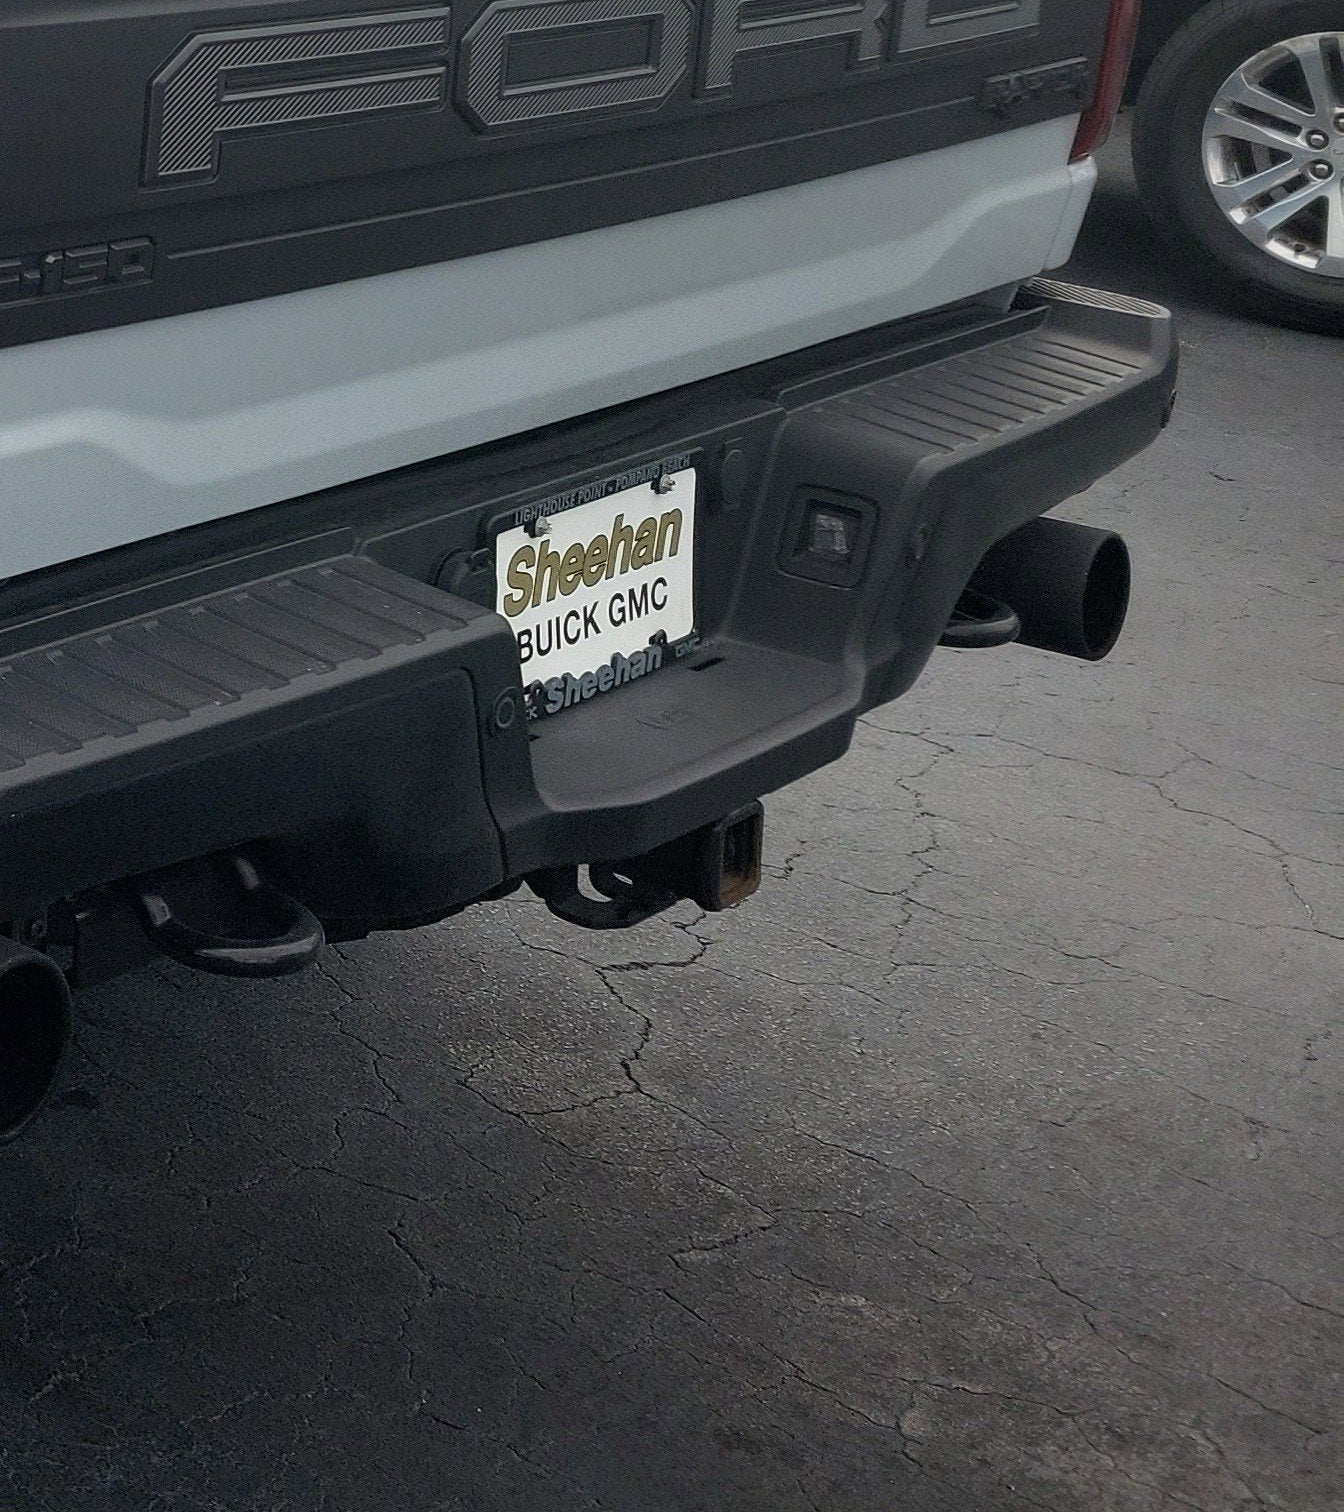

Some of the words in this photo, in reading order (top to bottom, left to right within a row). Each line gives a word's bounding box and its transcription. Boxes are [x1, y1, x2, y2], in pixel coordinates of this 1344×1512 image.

[514, 495, 575, 525] LIGHTHOUSE
[577, 482, 607, 506] POINT
[503, 508, 683, 618] Sheehan
[518, 601, 602, 664] BUICK
[608, 576, 668, 628] GMC
[545, 645, 663, 715] Sheehan
